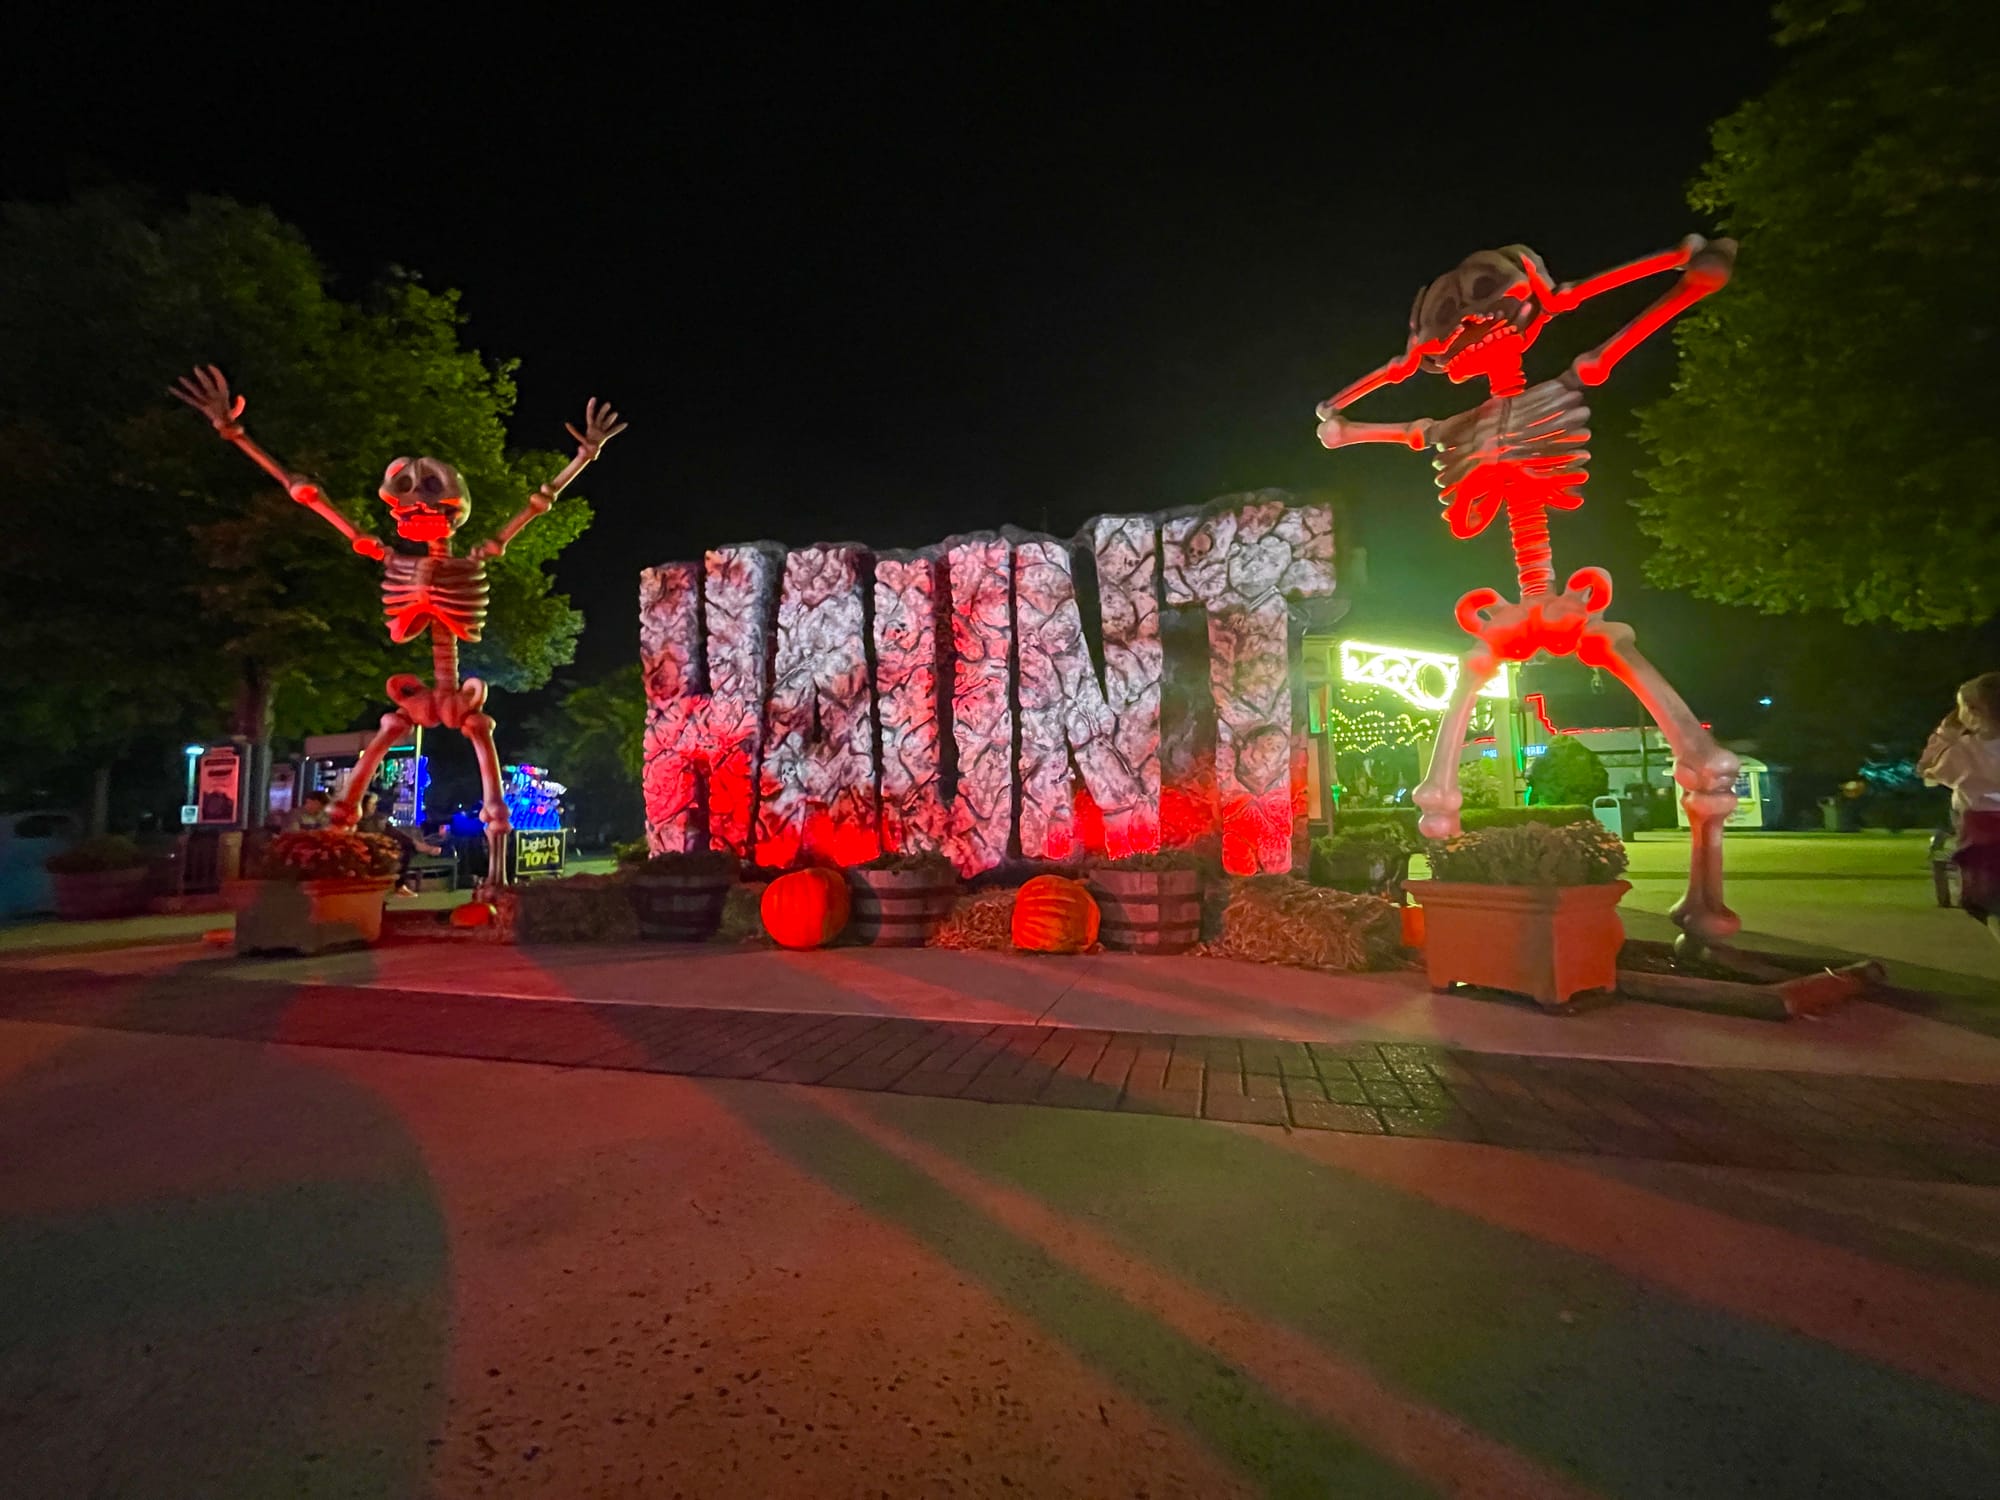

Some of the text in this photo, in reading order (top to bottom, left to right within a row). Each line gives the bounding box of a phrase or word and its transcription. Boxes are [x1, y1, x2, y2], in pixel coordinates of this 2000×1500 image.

[639, 502, 1336, 877] HAUNT
[548, 835, 561, 854] Up
[523, 851, 560, 867] TOYS
